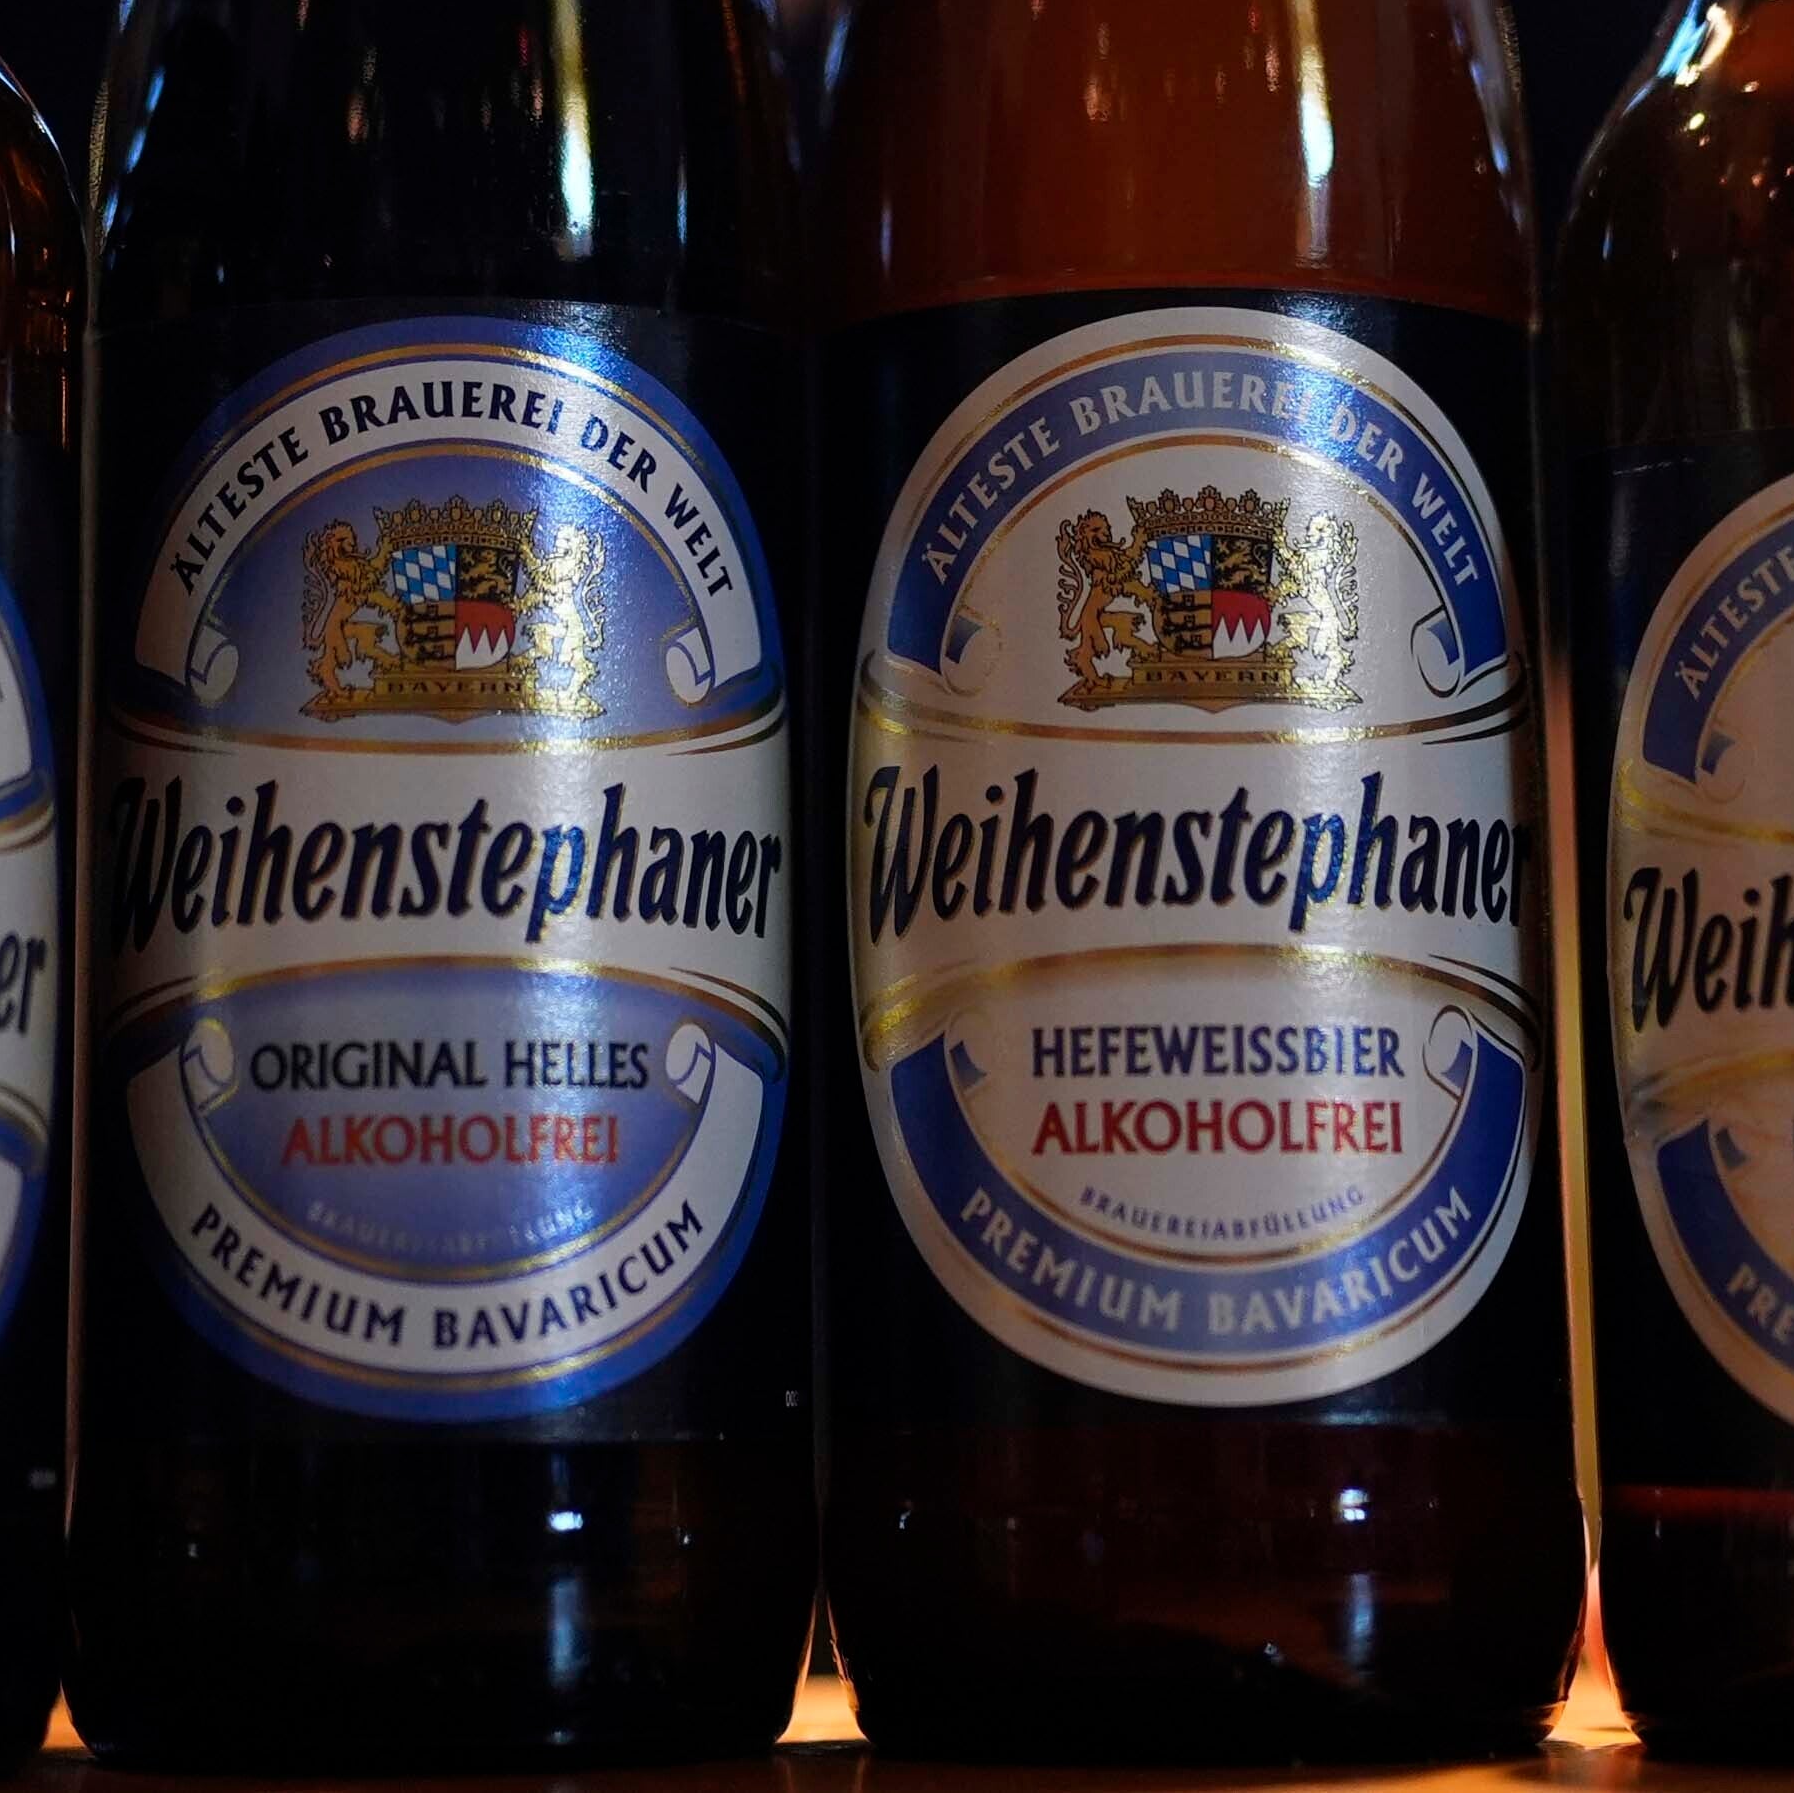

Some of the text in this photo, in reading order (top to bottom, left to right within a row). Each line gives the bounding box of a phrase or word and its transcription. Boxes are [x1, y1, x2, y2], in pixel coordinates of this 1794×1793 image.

[168, 380, 733, 598] ÄLTESTE BRAUEREI DER WELT
[921, 370, 1480, 587] ÄLTESTE BRAUEREI DER WELT
[1145, 667, 1282, 685] BAYERN
[110, 776, 782, 955] Weihenstephaner
[863, 763, 1534, 945] Weihenstephaner
[250, 1042, 649, 1093] ORIGINAL HELLES
[1031, 1024, 1405, 1079] HEFEWEISSBIER
[1031, 1099, 1404, 1157] ALKOHOLFREI
[280, 1114, 619, 1165] ALKOHOLFREI
[189, 1198, 706, 1351] PREMIUM BAVARICUM
[960, 1183, 1473, 1336] PREMIUM BAVARICUM
